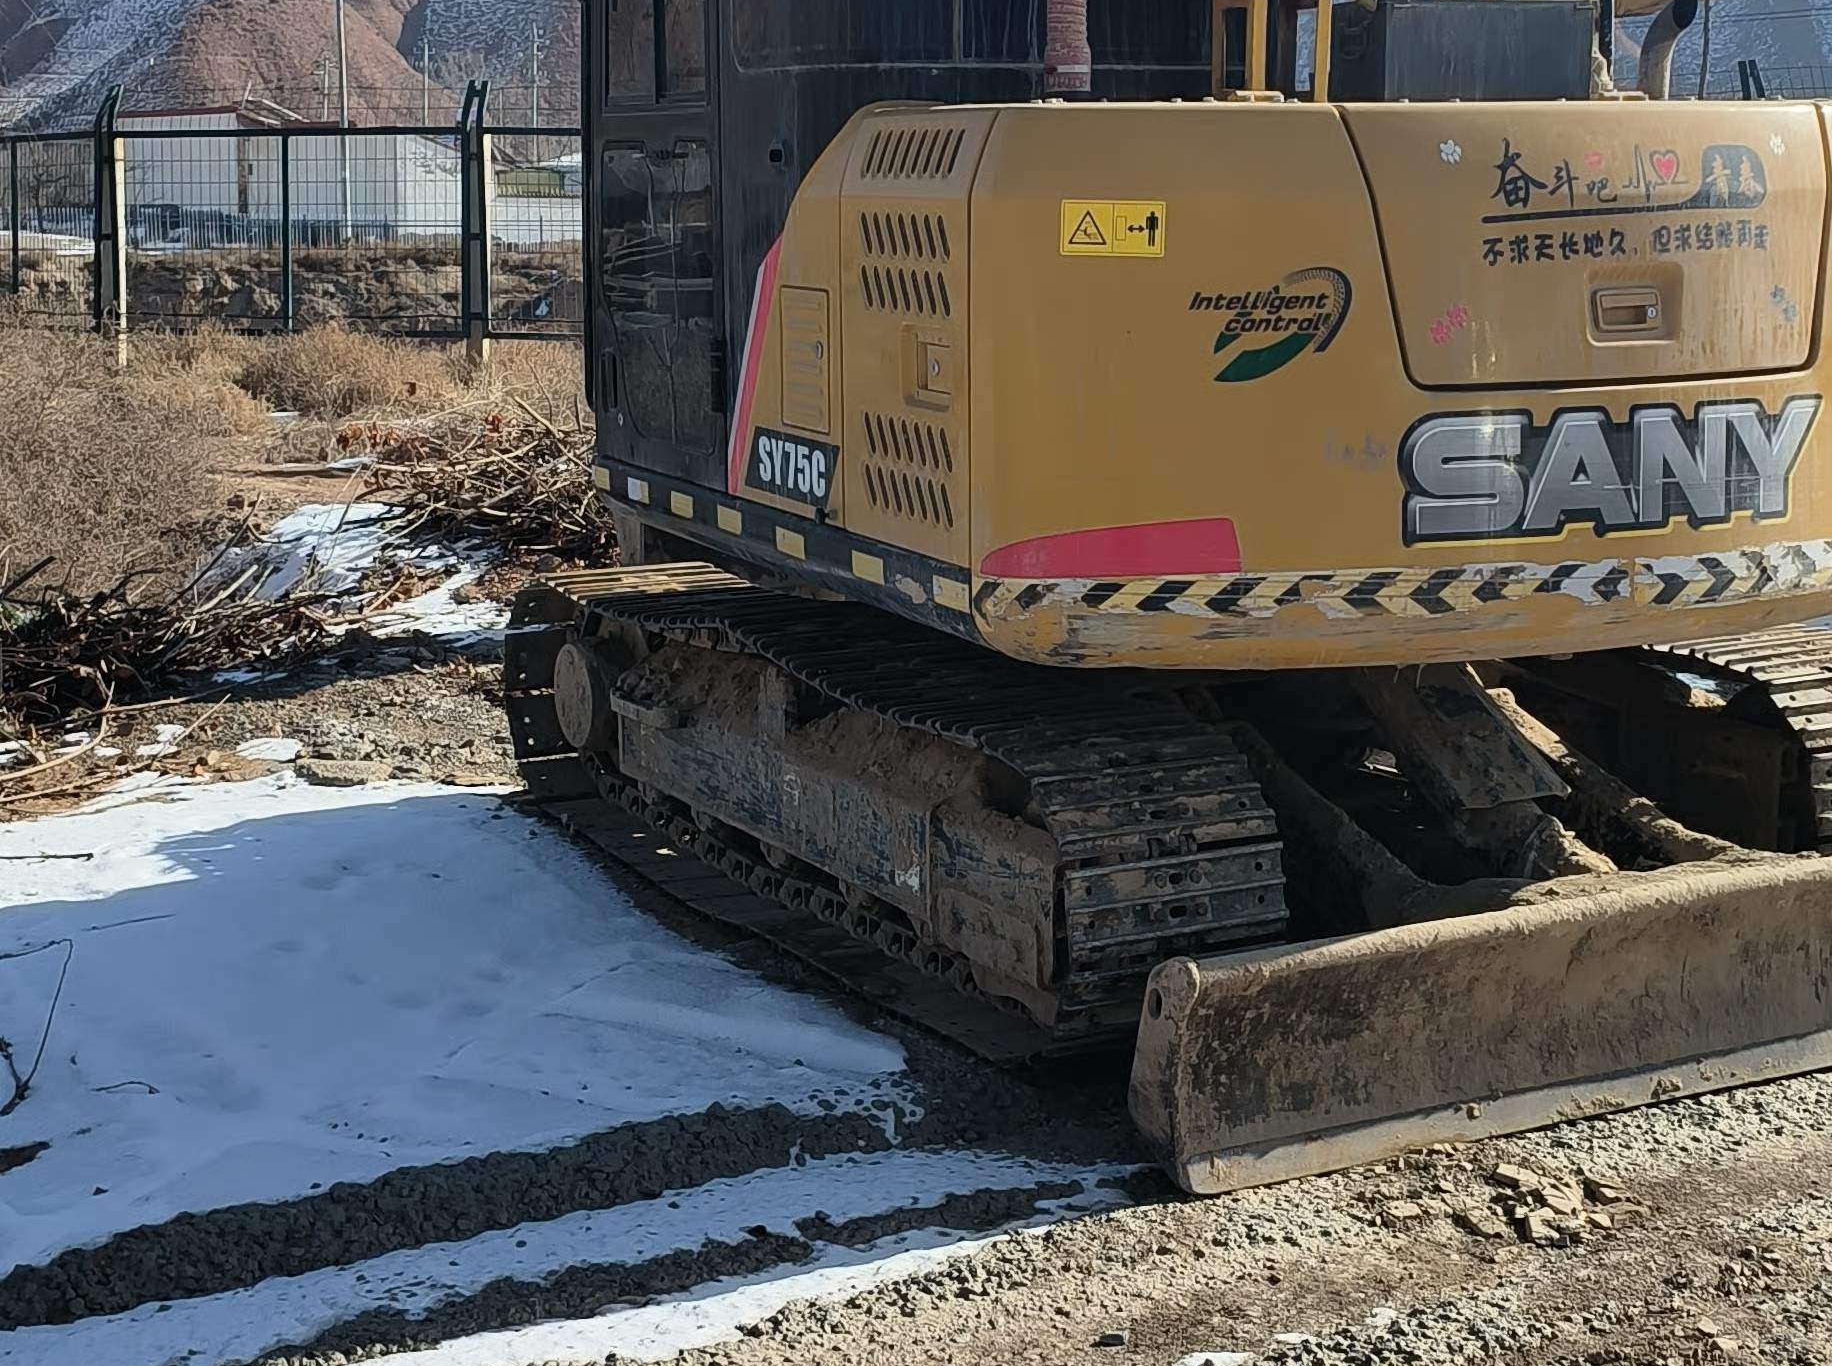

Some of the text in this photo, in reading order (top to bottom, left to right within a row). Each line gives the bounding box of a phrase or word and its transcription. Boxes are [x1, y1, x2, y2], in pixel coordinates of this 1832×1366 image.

[1489, 137, 1765, 210] 奋斗吧 青春
[1188, 290, 1331, 316] Intelligent
[1223, 312, 1326, 335] control
[757, 435, 826, 498] SY75C
[1402, 397, 1820, 543] SANY
